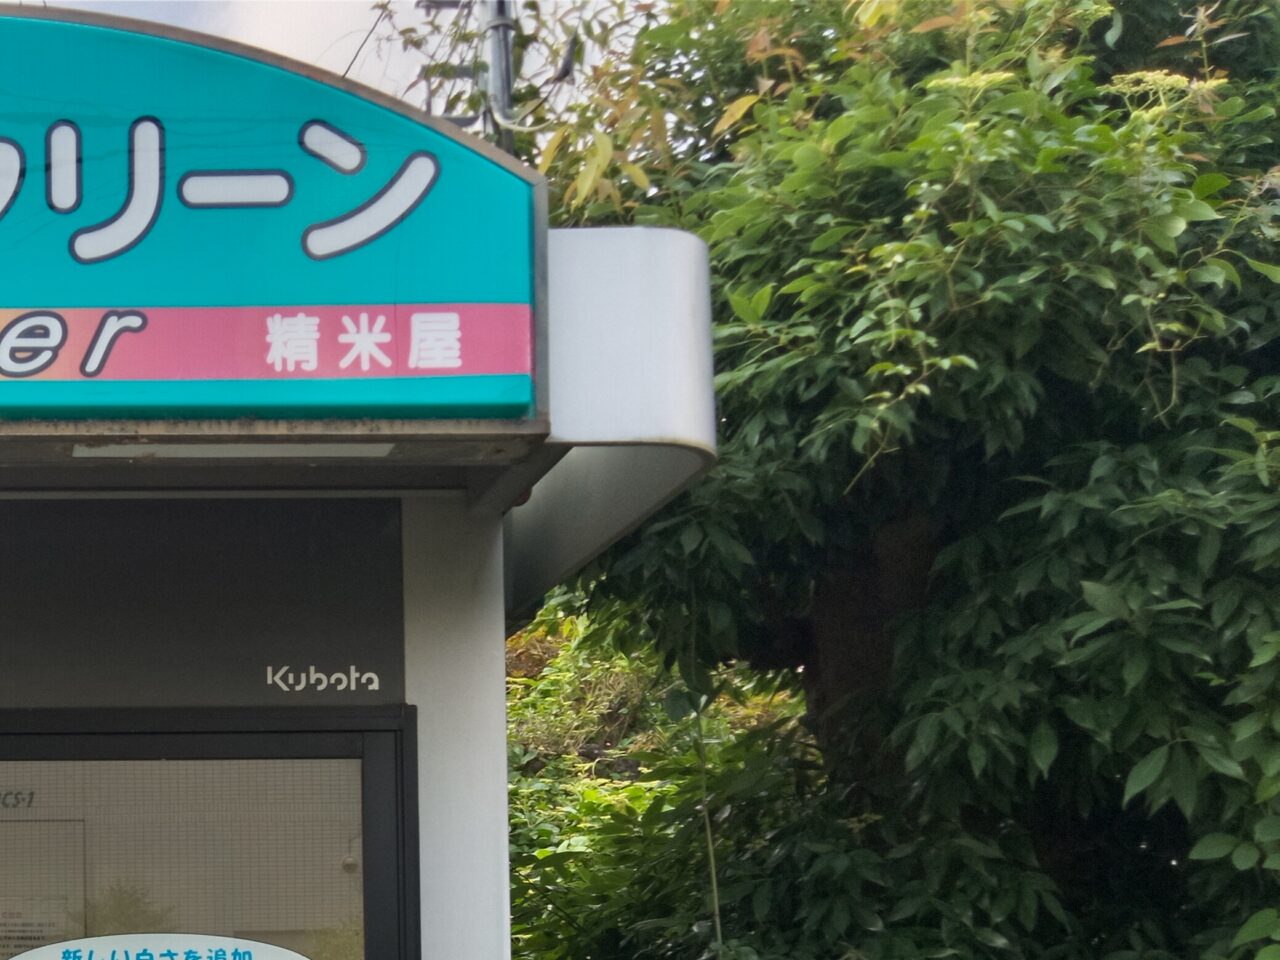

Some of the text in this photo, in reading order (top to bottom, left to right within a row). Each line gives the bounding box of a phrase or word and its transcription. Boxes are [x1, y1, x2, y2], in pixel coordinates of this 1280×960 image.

[264, 312, 462, 372] 精米屋
[267, 665, 380, 691] Kubota
